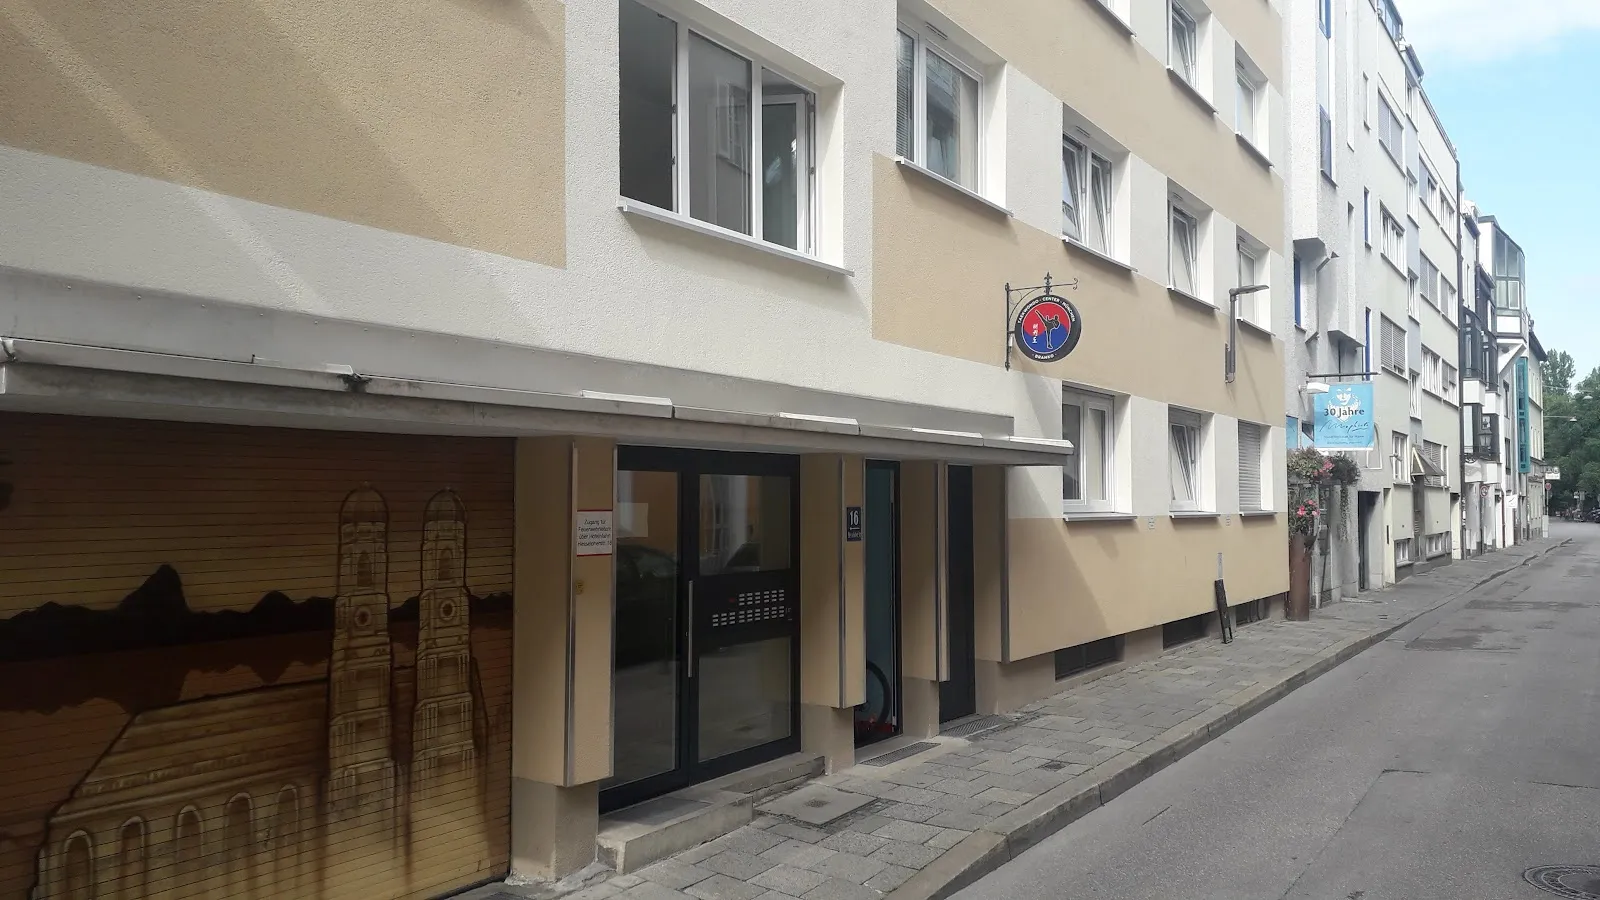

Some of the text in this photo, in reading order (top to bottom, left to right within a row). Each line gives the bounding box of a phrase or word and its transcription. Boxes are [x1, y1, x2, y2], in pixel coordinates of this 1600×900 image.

[1017, 299, 1040, 324] TAEKWONDO
[1062, 301, 1076, 322] MÜNCHEN
[1324, 406, 1365, 418] 30 Jahre
[849, 510, 859, 526] 16
